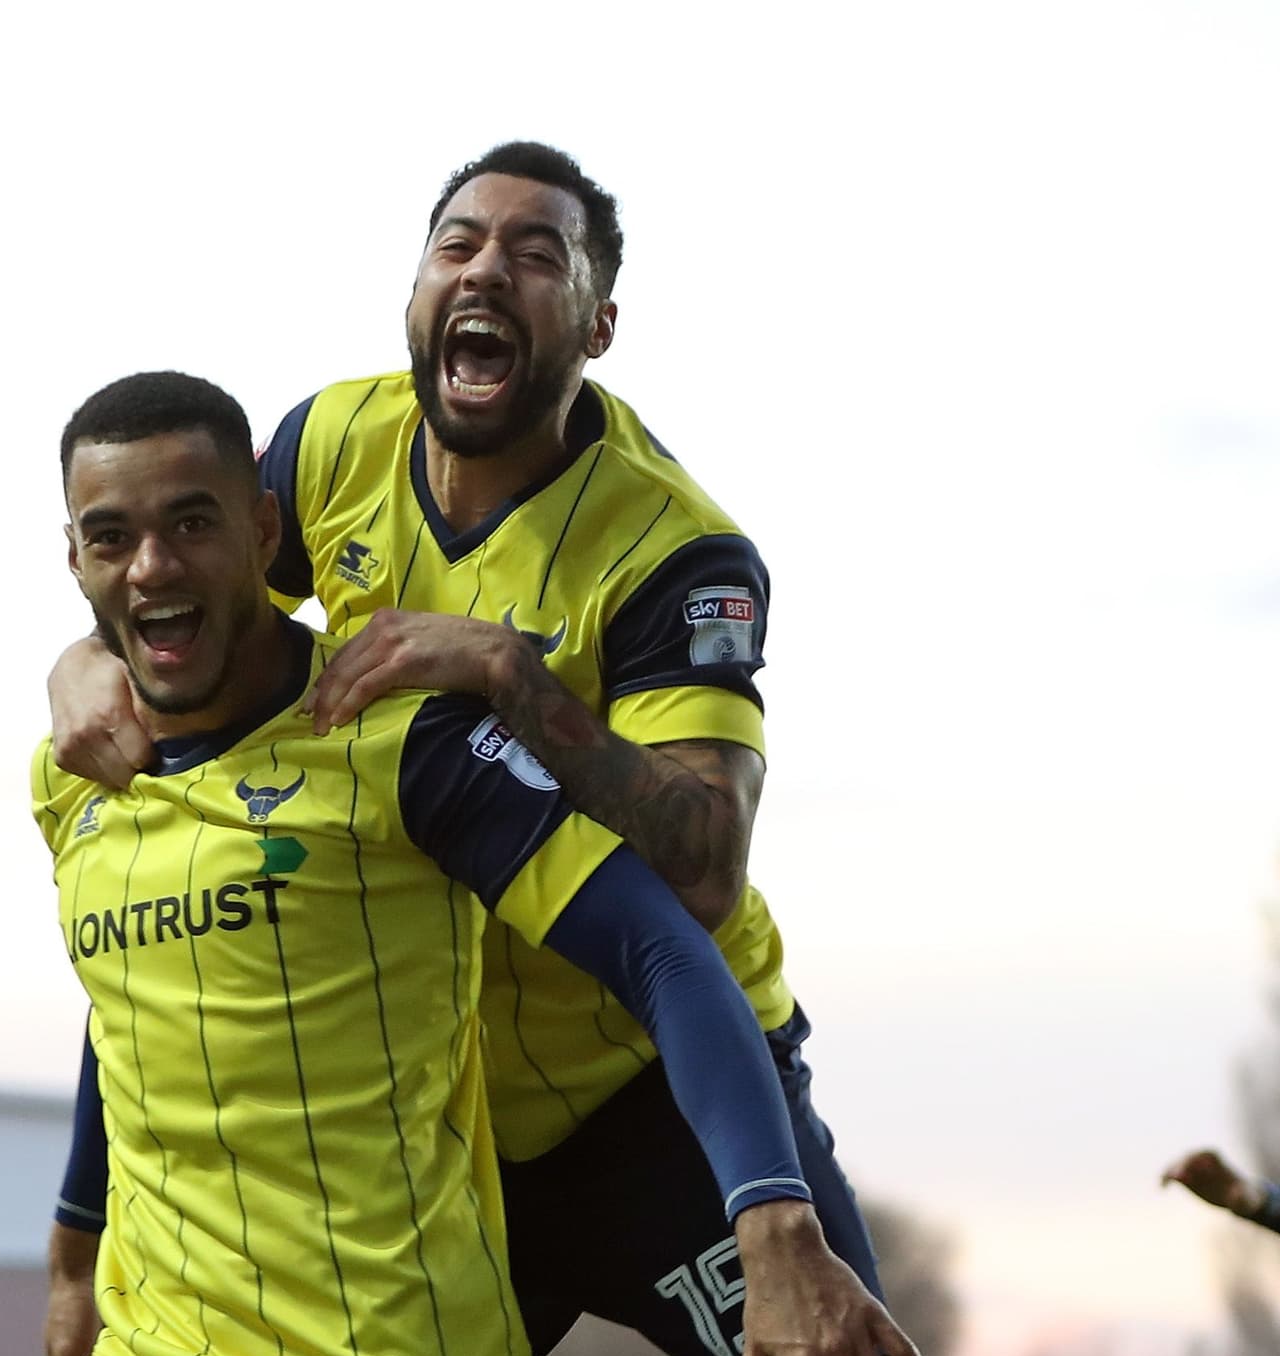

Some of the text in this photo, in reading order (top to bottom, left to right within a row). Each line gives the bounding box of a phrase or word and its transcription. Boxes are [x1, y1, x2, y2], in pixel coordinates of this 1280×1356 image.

[689, 601, 749, 617] sky BET
[480, 732, 504, 756] sky
[70, 880, 289, 964] IONTRUST
